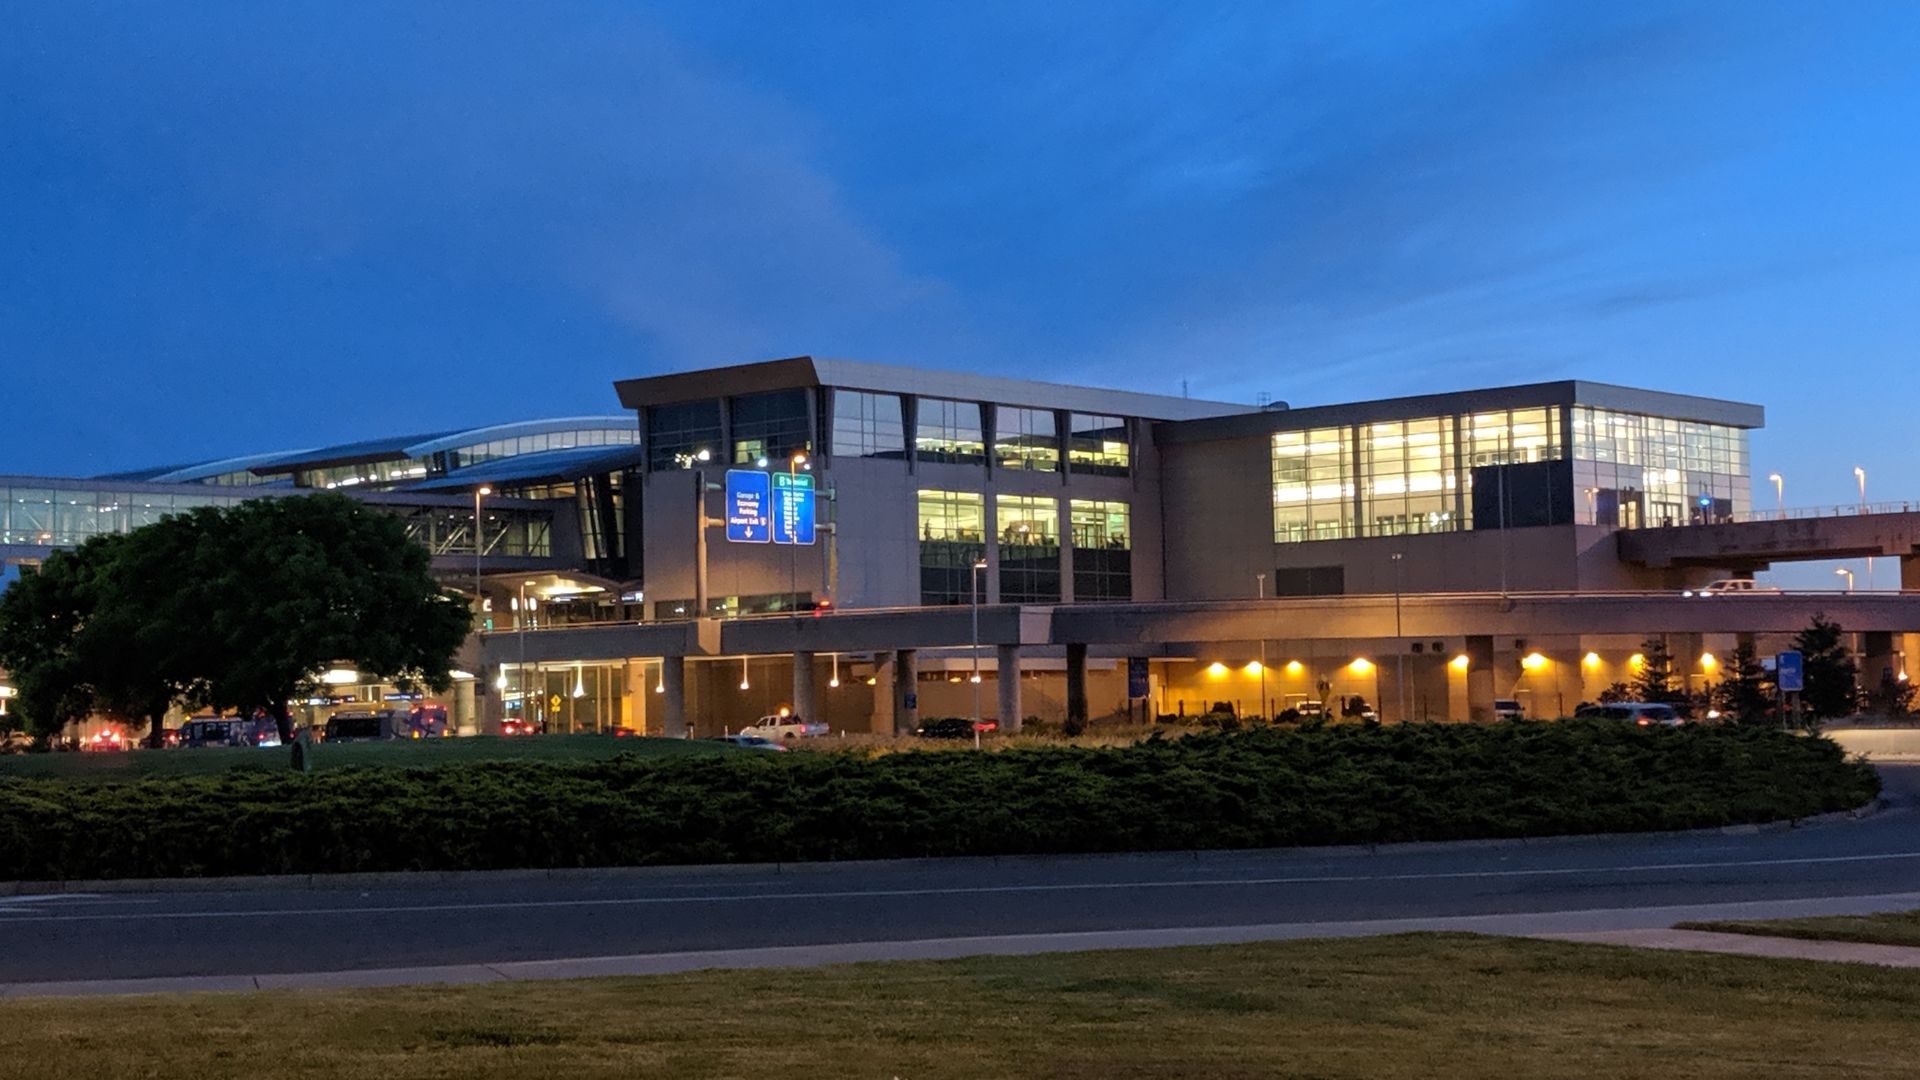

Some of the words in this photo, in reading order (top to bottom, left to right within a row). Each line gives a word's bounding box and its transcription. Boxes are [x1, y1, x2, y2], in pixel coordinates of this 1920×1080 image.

[786, 478, 808, 486] Teminal
[737, 500, 759, 508] Economy
[739, 508, 758, 517] Parking
